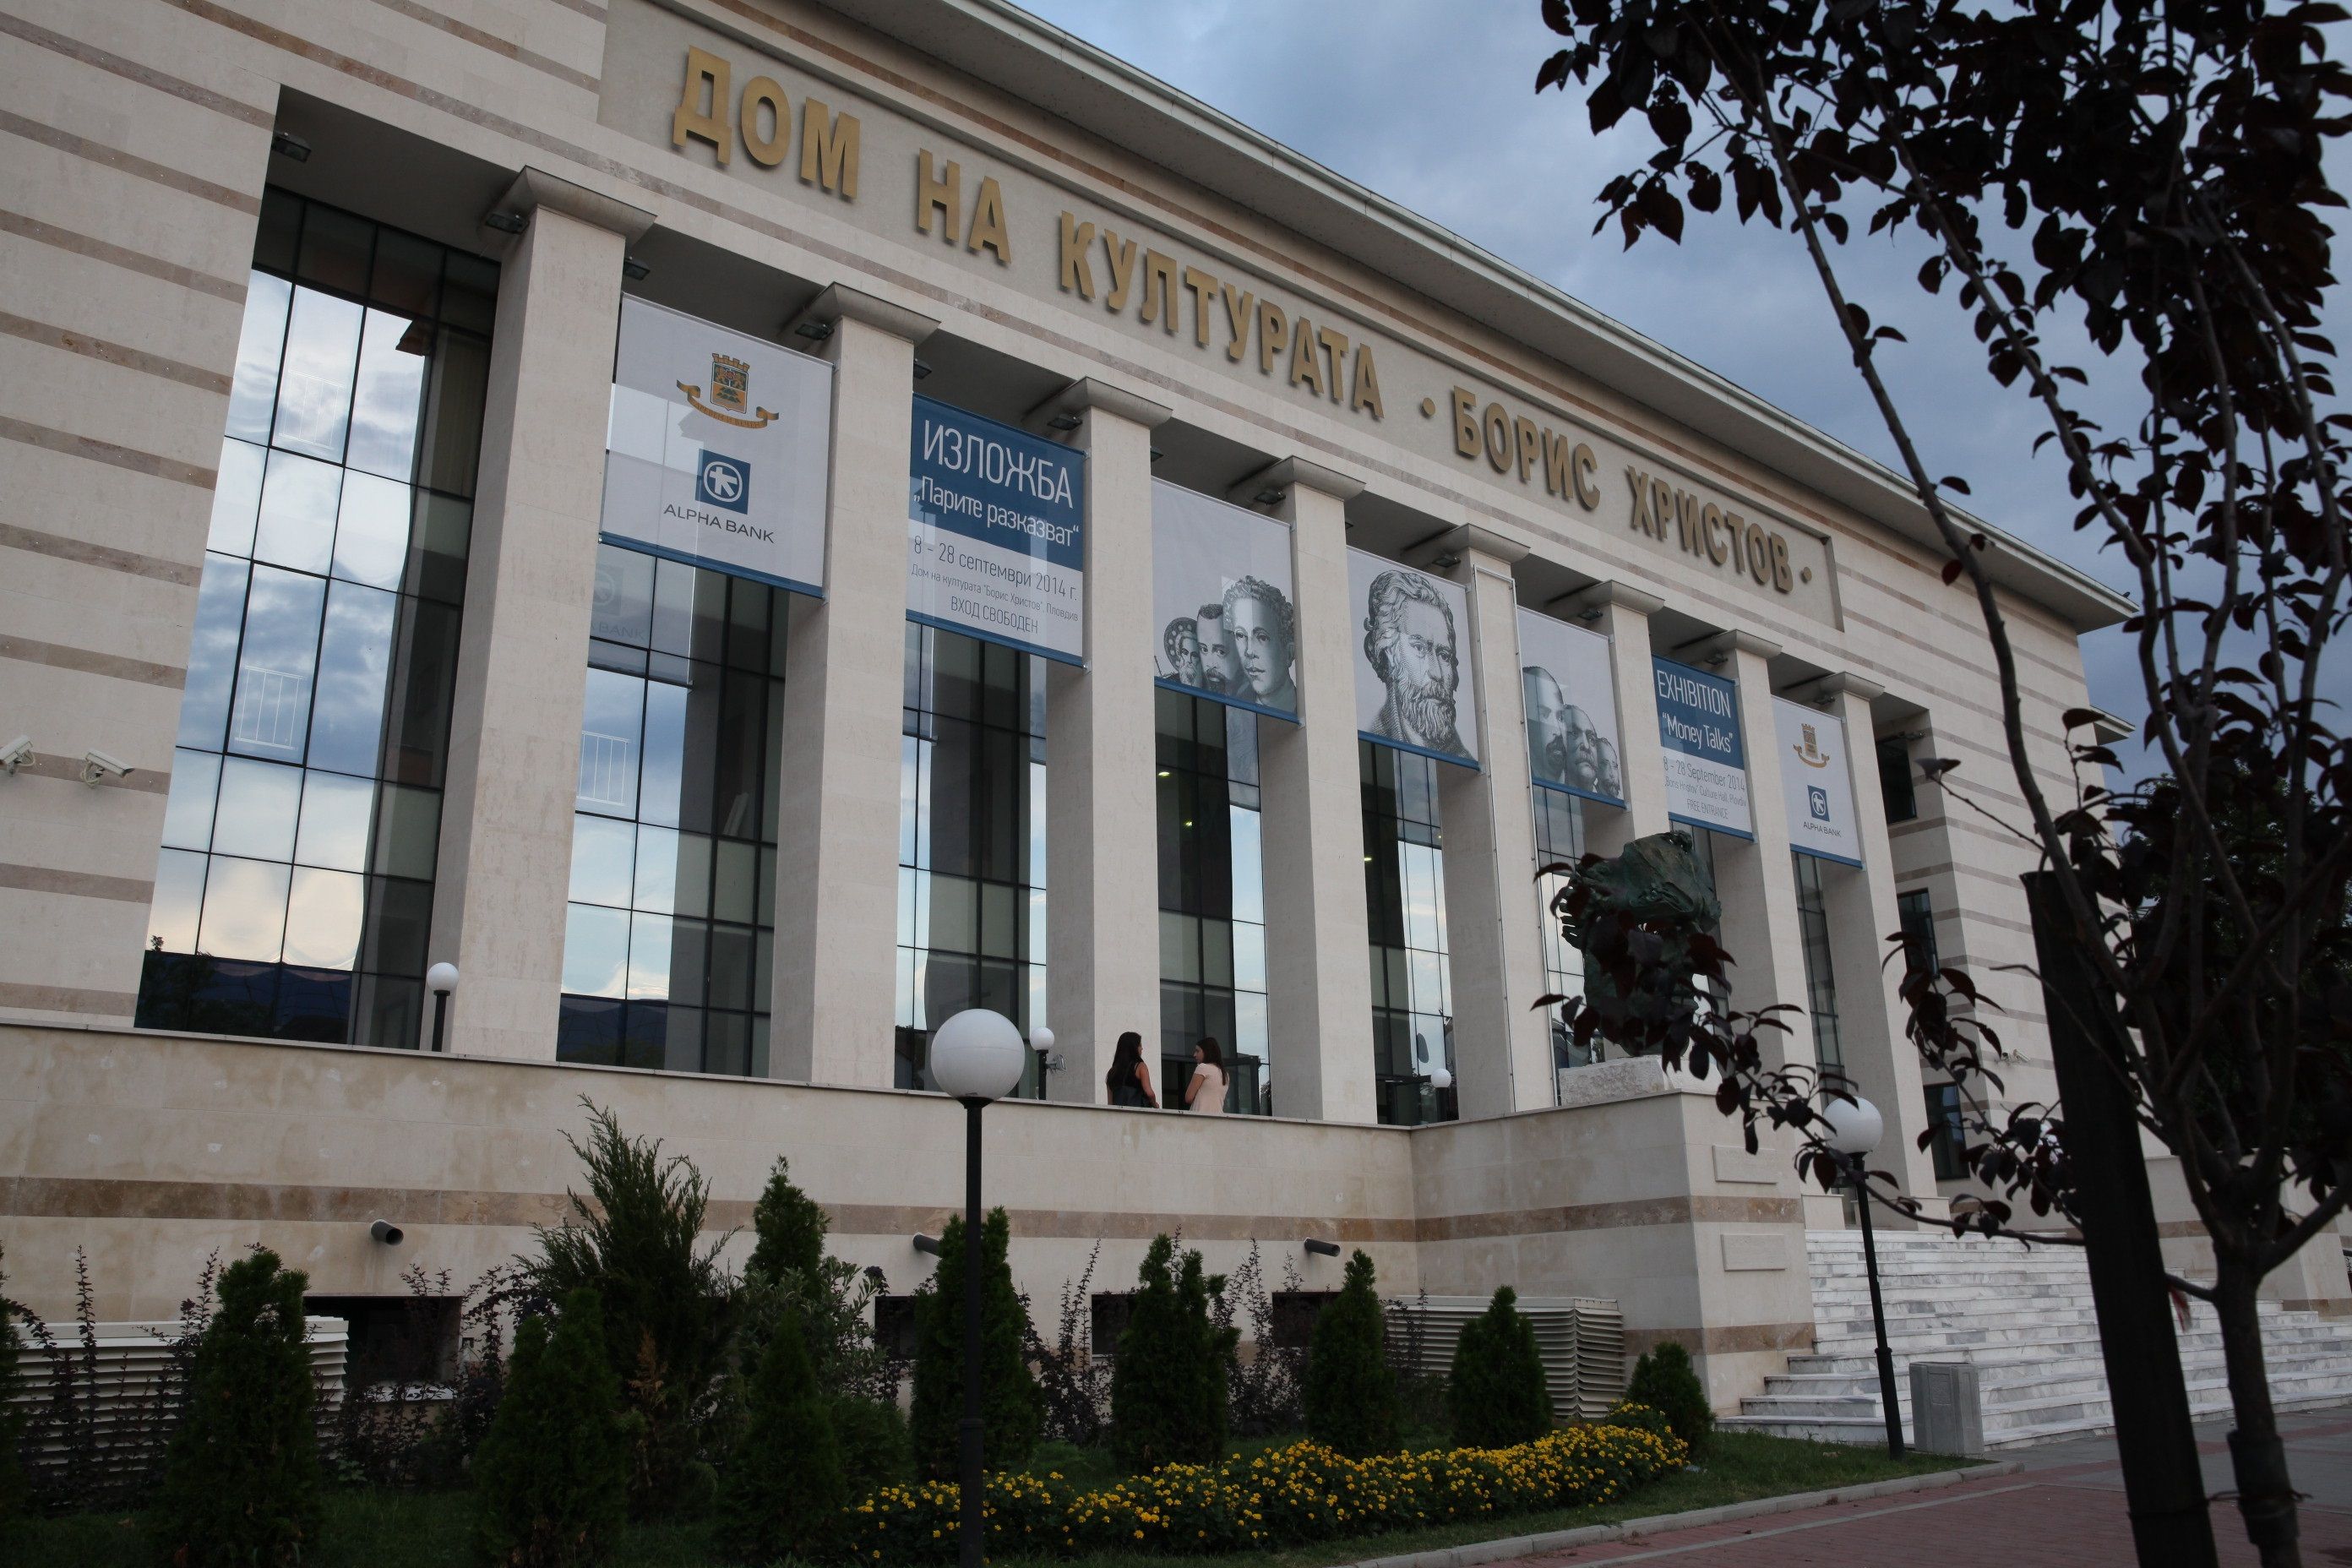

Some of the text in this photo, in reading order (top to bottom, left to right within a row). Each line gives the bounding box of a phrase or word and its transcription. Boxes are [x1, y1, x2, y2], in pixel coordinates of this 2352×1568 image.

[672, 45, 1794, 592] ДОМ НА КУЛТУРАТА БОРИС ХРИСТОВ
[924, 420, 1073, 509] ИЗЛОЖБА
[664, 504, 774, 543] ALPHA BANK
[912, 564, 928, 578] Дом
[932, 572, 940, 582] на
[1047, 602, 1079, 621] Пловдив
[914, 536, 922, 554] 8
[939, 542, 955, 564] 28
[959, 553, 1032, 587] септември
[1036, 572, 1066, 596] 2014
[1070, 585, 1077, 602] г.
[951, 596, 1038, 634] ВХОД СВОБОДЕН
[1657, 669, 1731, 718] EXHIBITION
[1663, 755, 1669, 771] 8
[1687, 763, 1726, 787] September
[1727, 774, 1745, 792] 2014
[1804, 821, 1842, 837] ALPHA BANK
